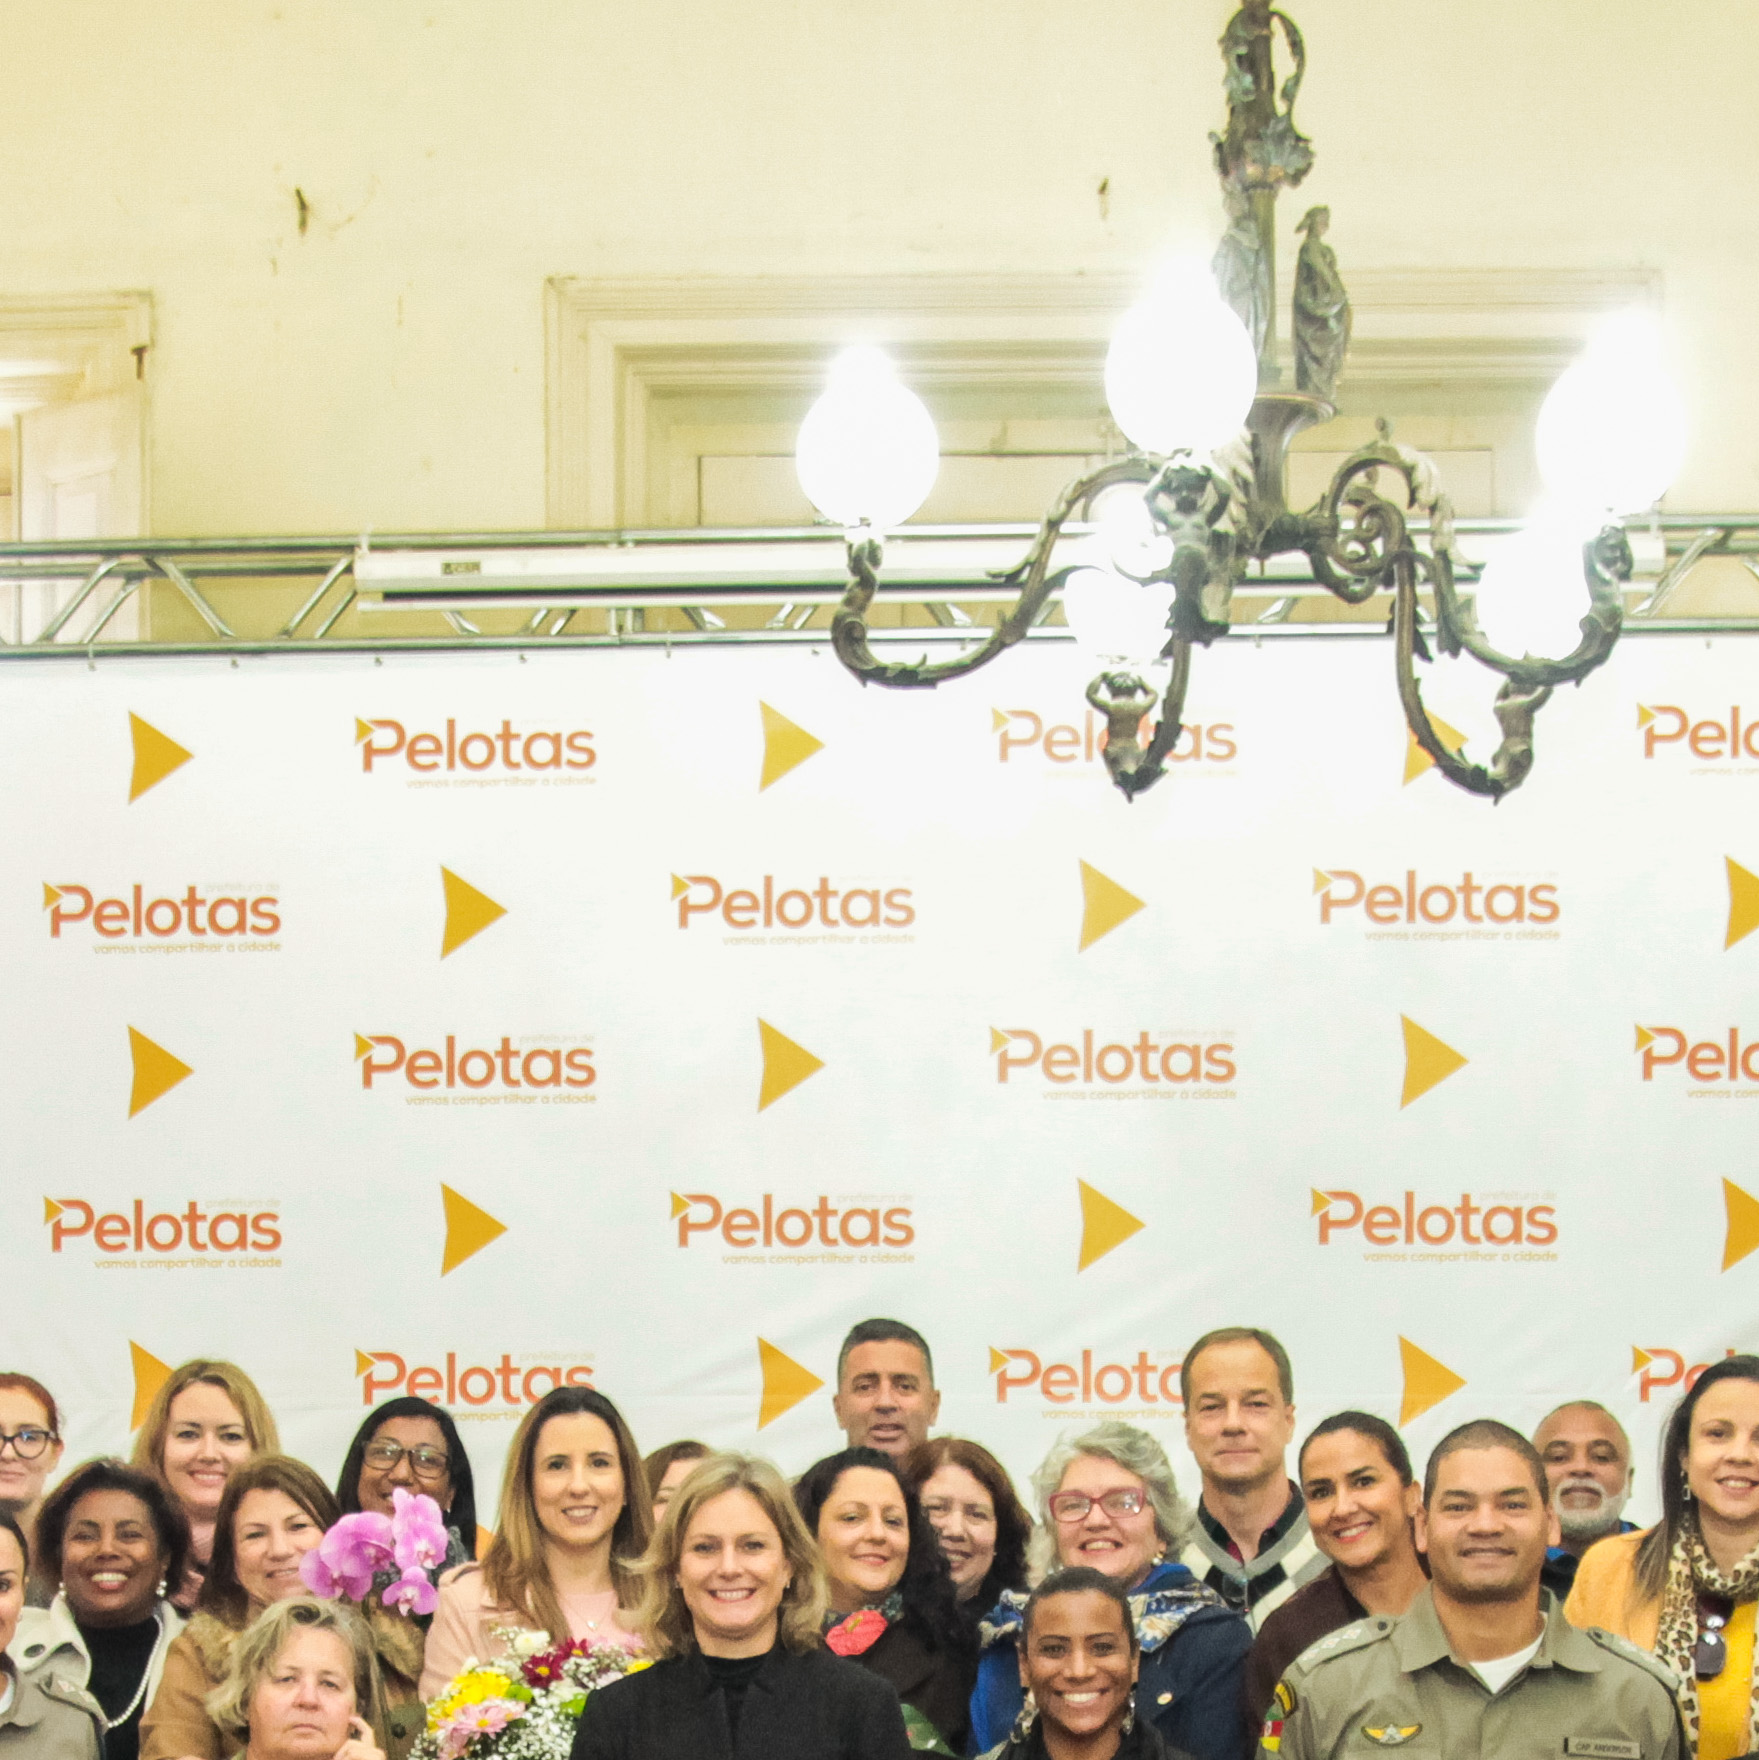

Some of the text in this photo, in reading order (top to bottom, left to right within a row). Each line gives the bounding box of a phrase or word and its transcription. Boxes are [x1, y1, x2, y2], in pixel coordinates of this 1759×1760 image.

[362, 716, 598, 772] Pelotas
[998, 709, 1238, 763] Pelas
[50, 882, 282, 938] Pelotas
[678, 874, 917, 929] Pelotas
[1321, 869, 1562, 925] Pelotas
[92, 945, 136, 954] vamos
[139, 941, 223, 955] compartilhar
[237, 941, 282, 952] cidade
[1364, 931, 1410, 941] vamos
[1412, 929, 1501, 943] compartilhar
[1515, 929, 1561, 940] cidade
[362, 1034, 597, 1089] Pelotas
[998, 1028, 1238, 1084] Pelotas
[405, 1096, 449, 1105] vamos
[452, 1093, 538, 1107] compartilhar
[552, 1093, 597, 1104] cidade
[1041, 1091, 1087, 1100] vamos
[1089, 1088, 1177, 1102] compartilhar
[1191, 1088, 1237, 1100] cidade
[1686, 1089, 1732, 1098] vamos
[51, 1198, 282, 1252] Pelotas
[678, 1193, 916, 1248] Pelotas
[1319, 1189, 1560, 1246] Pelotas
[94, 1260, 137, 1269] vamos
[140, 1257, 224, 1270] compartilhar
[238, 1257, 282, 1268] cidade
[721, 1255, 766, 1264] vamos
[769, 1252, 856, 1266] compartilhar
[870, 1252, 915, 1264] cidade
[1362, 1253, 1408, 1262] vamos
[1410, 1250, 1499, 1264] compartilhar
[1513, 1250, 1559, 1262] cidade
[1040, 1409, 1176, 1423] vamos compartilhar
